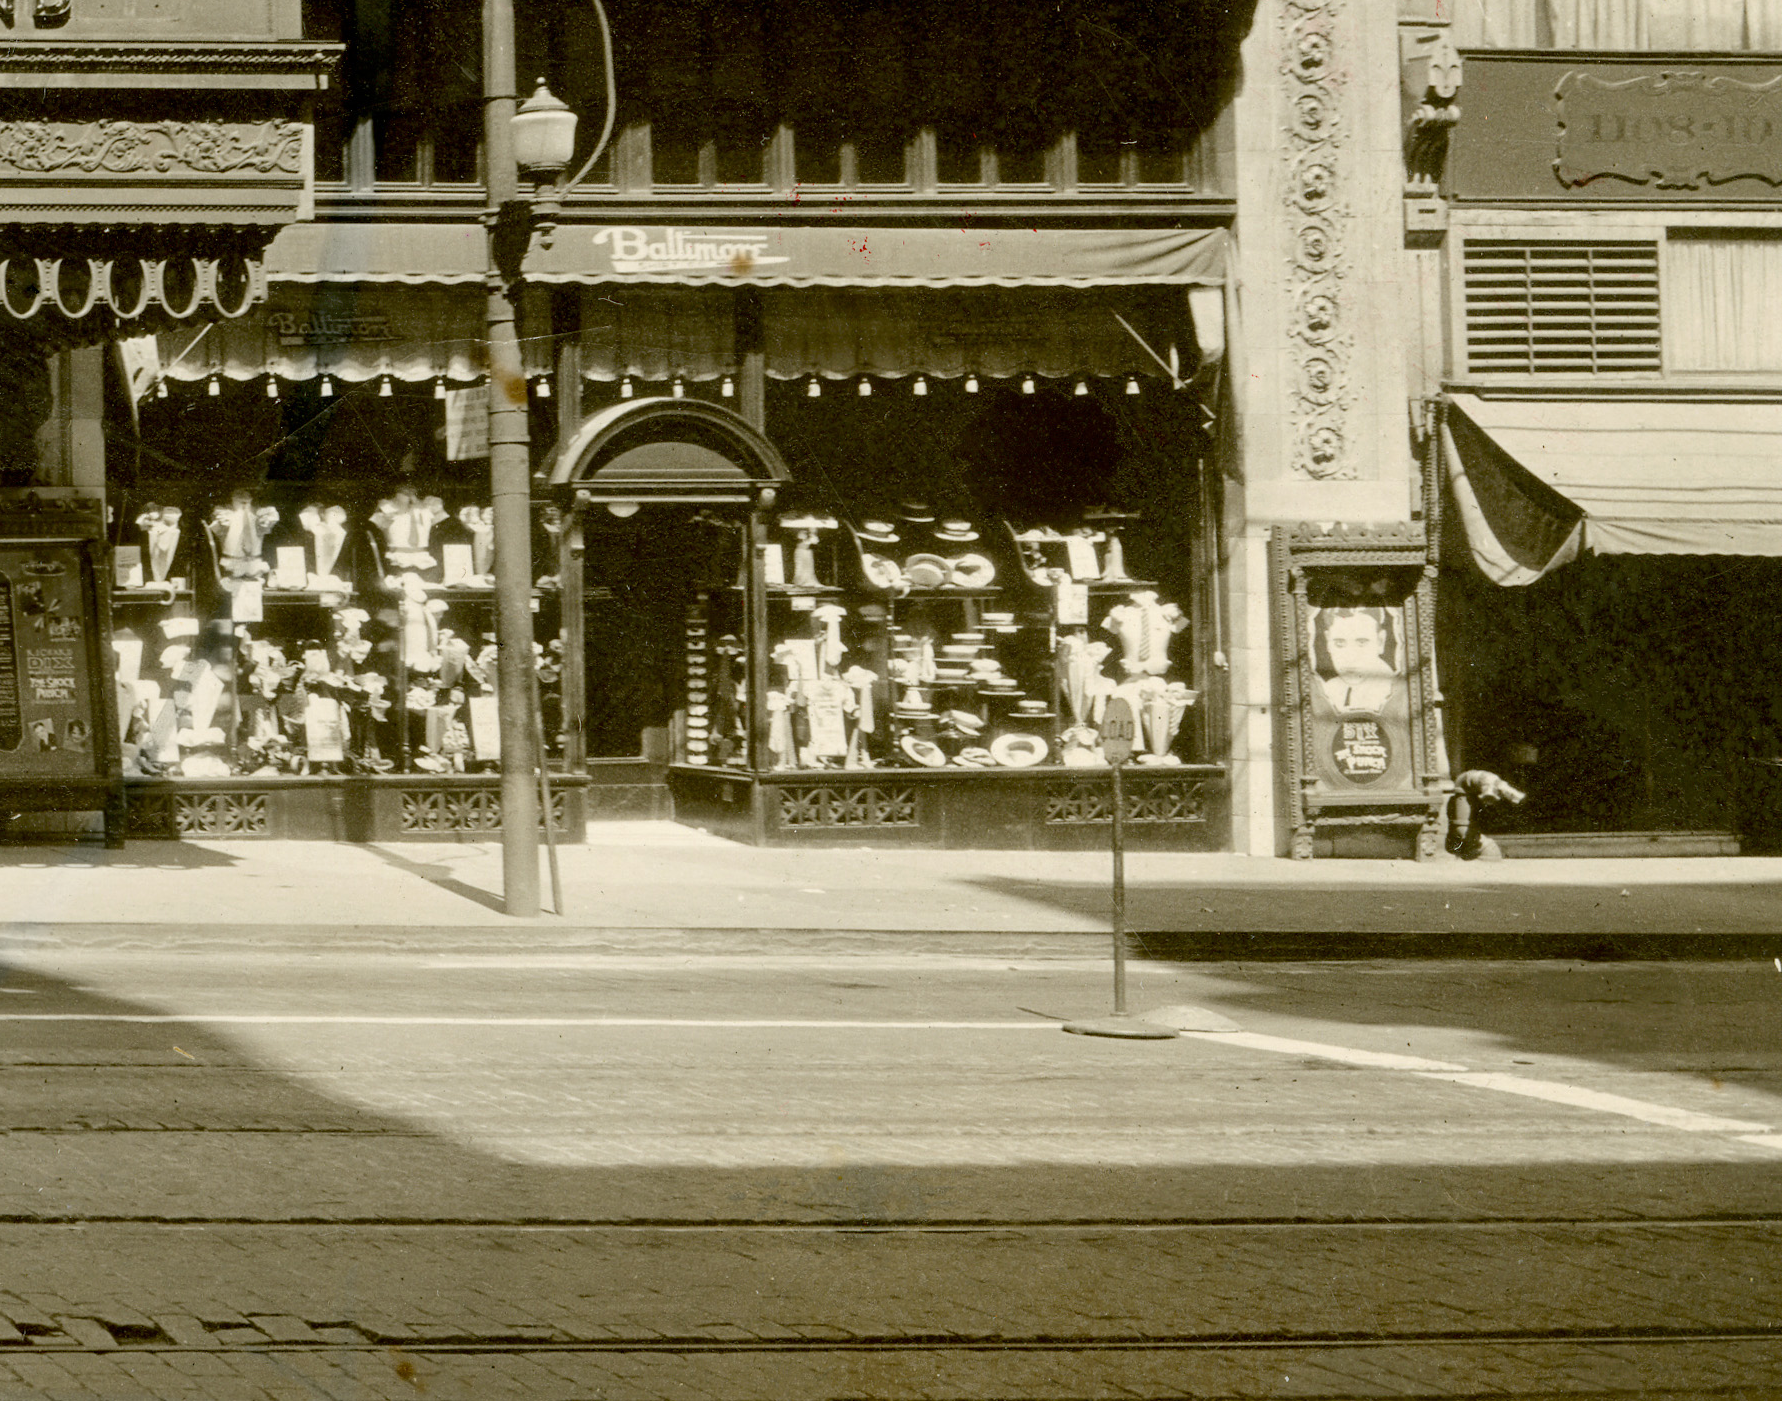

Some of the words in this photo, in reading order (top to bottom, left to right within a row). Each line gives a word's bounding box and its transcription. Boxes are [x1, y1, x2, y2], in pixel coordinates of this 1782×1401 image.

[593, 227, 790, 263] Baltimore
[26, 656, 75, 669] DIX
[1343, 726, 1380, 740] DIX
